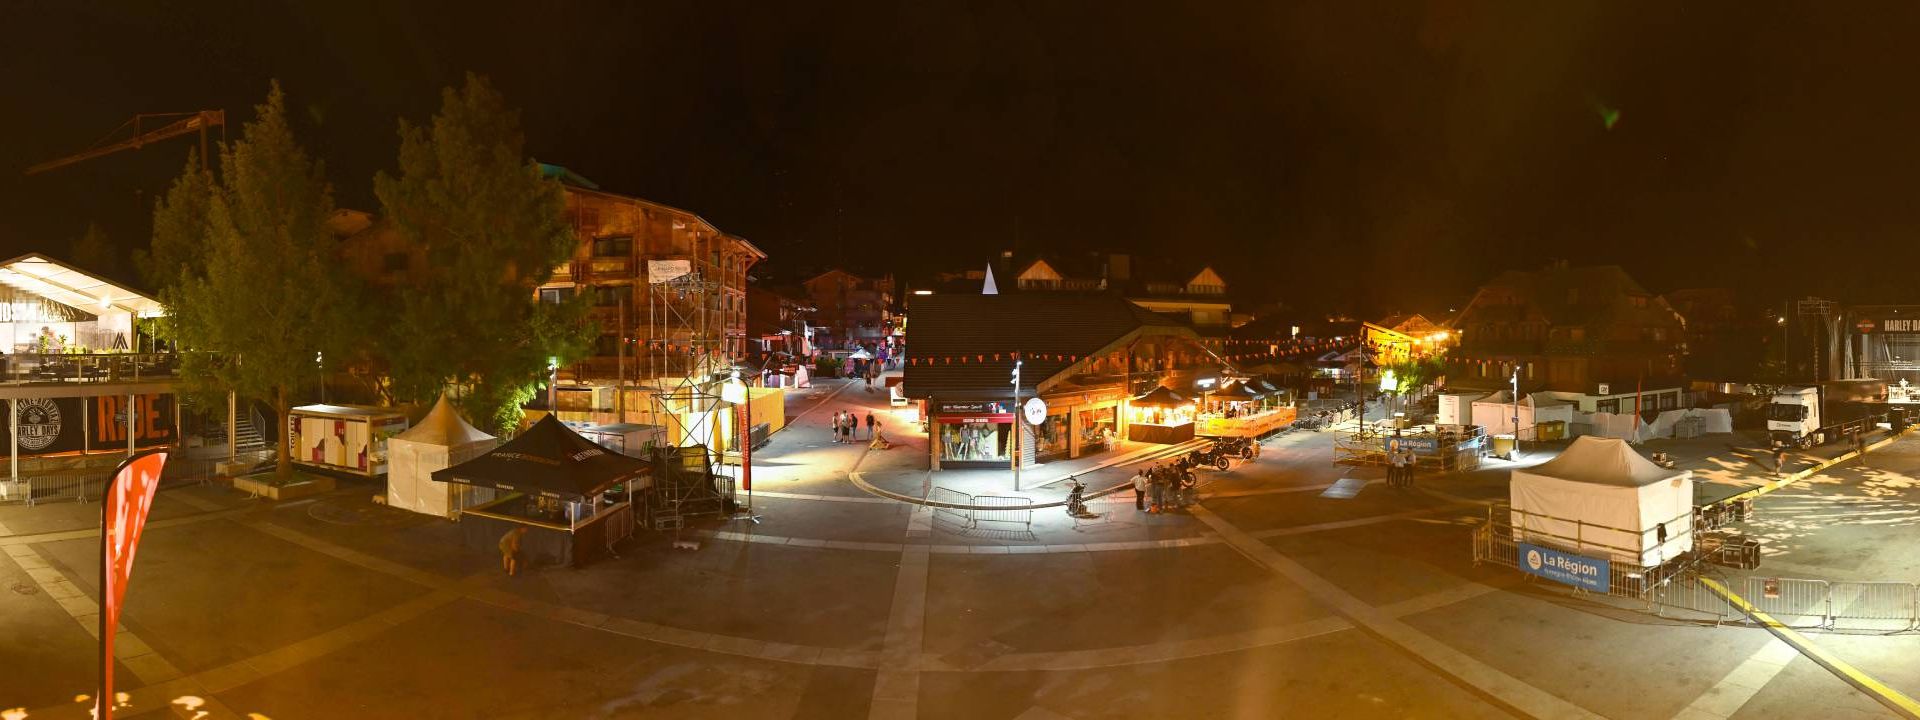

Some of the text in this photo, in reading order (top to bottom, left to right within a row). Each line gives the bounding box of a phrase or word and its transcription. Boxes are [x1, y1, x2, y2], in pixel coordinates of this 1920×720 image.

[1884, 319, 1911, 332] HARLEY
[17, 424, 38, 436] ARLEY
[1543, 552, 1597, 577] La Région
